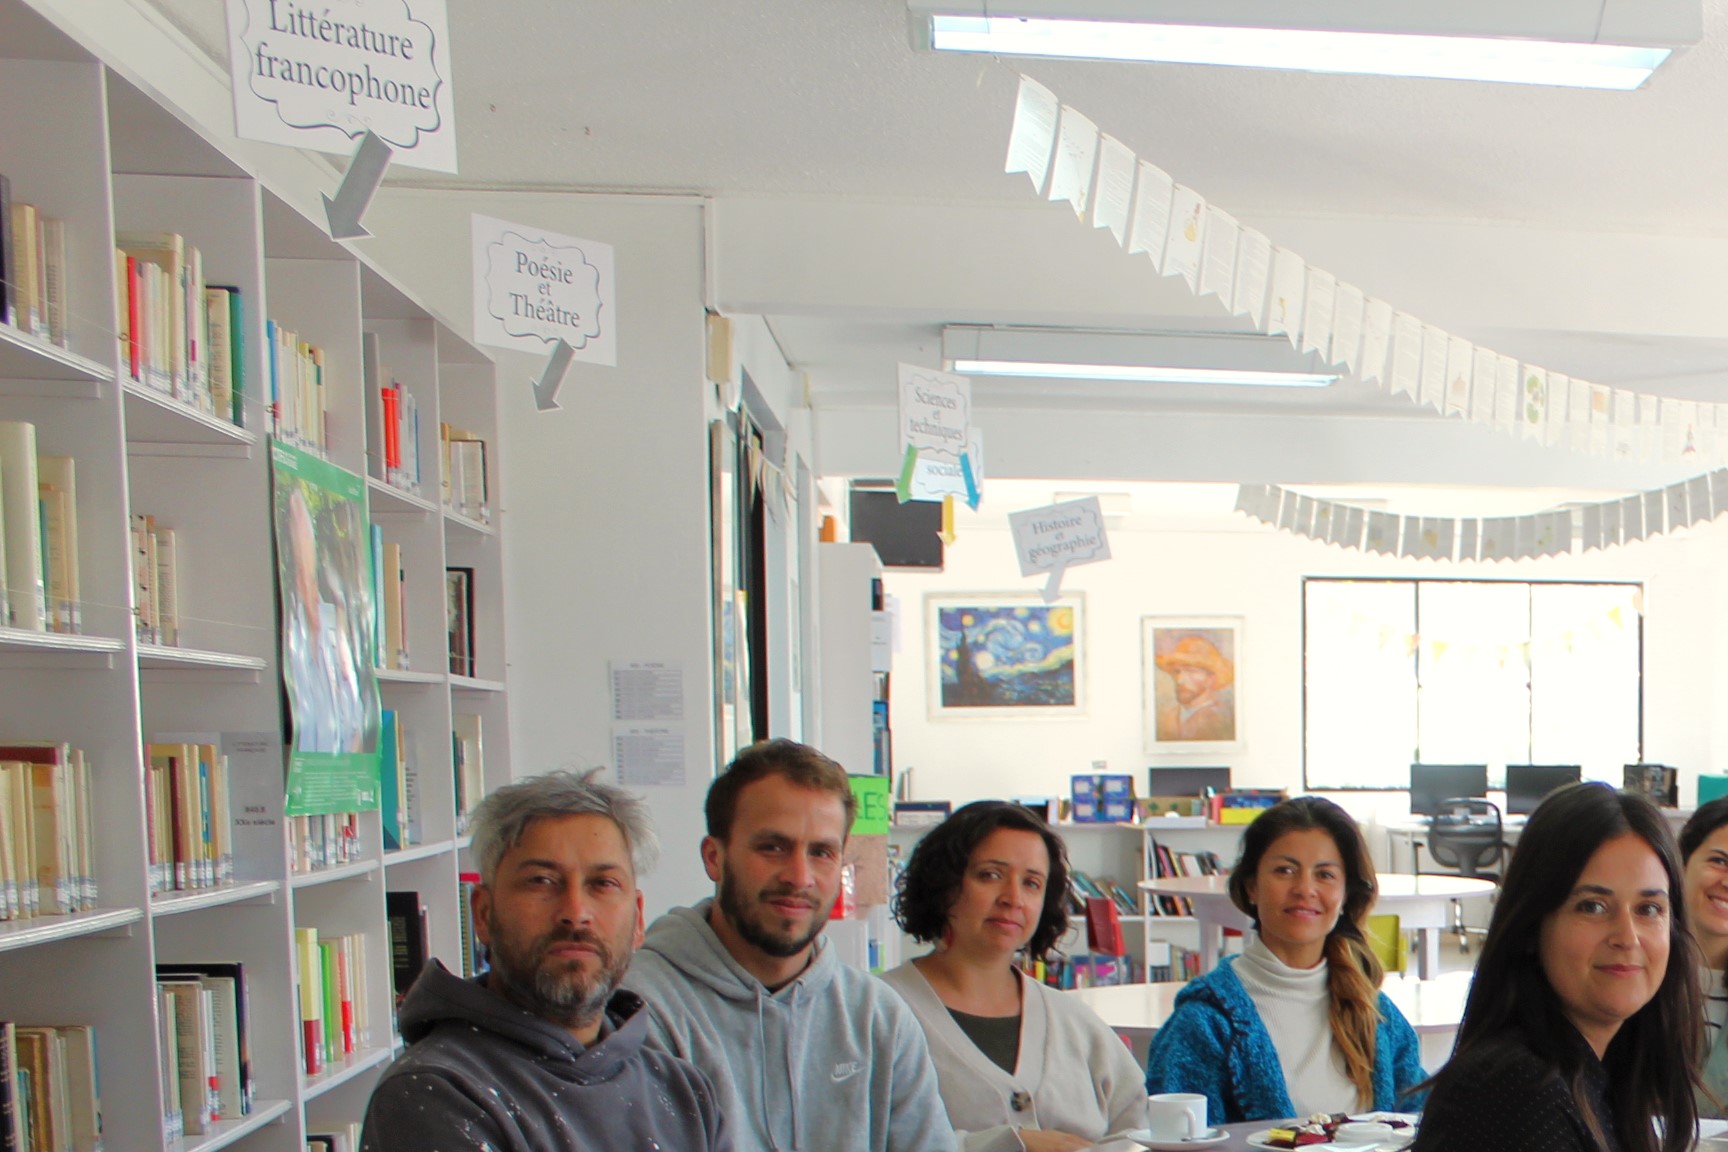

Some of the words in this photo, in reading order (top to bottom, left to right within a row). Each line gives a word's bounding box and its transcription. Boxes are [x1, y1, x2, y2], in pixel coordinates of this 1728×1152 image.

[269, 0, 414, 60] Littérature
[255, 41, 431, 109] francophone
[515, 250, 573, 284] Poésie
[538, 283, 552, 296] et
[509, 292, 580, 327] Théâtre
[914, 386, 957, 410] Sciences
[910, 416, 963, 443] techniques
[1032, 515, 1082, 535] Histoire
[1054, 531, 1065, 541] et
[1028, 534, 1096, 564] géographie
[835, 1061, 858, 1077] NIKE
